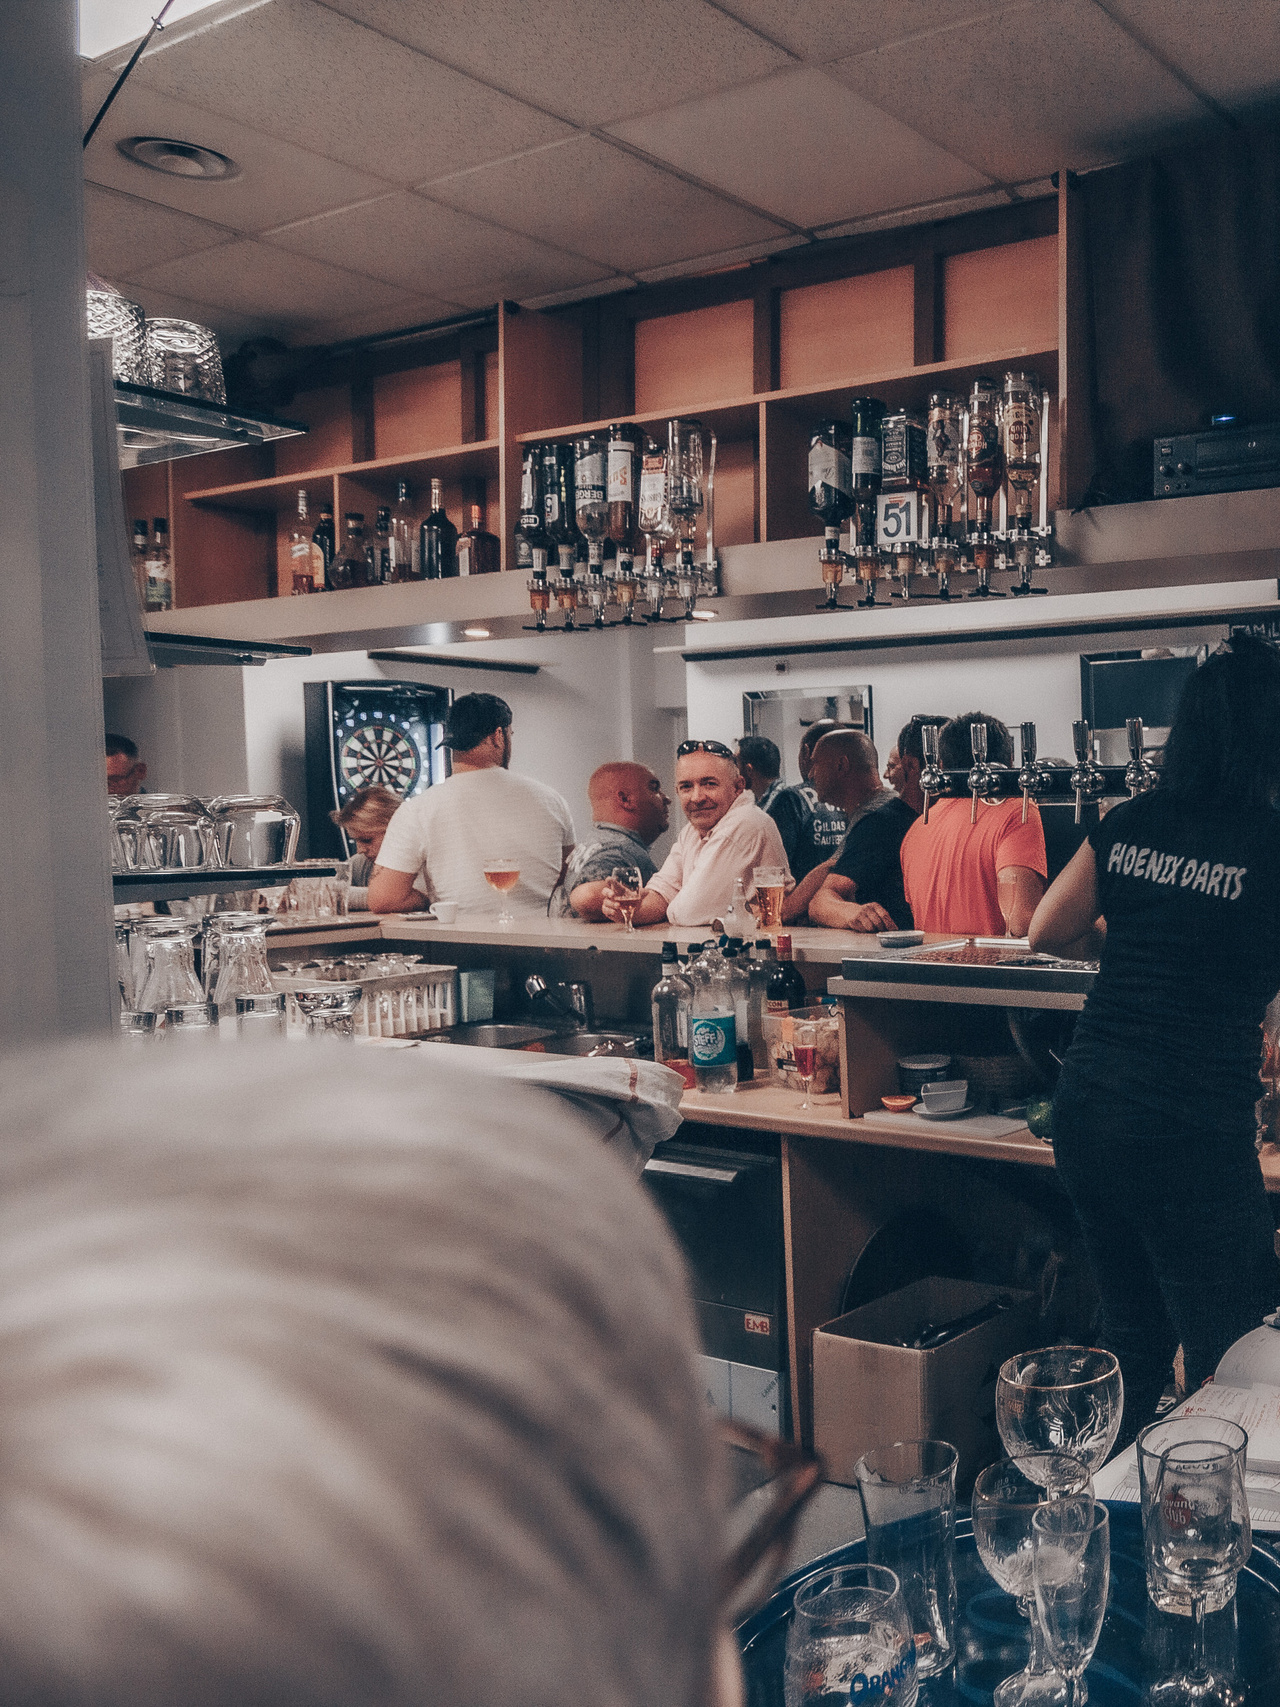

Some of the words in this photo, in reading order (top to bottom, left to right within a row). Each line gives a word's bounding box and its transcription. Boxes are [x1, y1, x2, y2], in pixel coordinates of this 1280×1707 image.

[883, 501, 911, 537] 51
[813, 819, 846, 832] GILDAS
[1107, 842, 1185, 885] PHOENIX
[1180, 858, 1247, 900] DARTS
[745, 1318, 769, 1333] EMB
